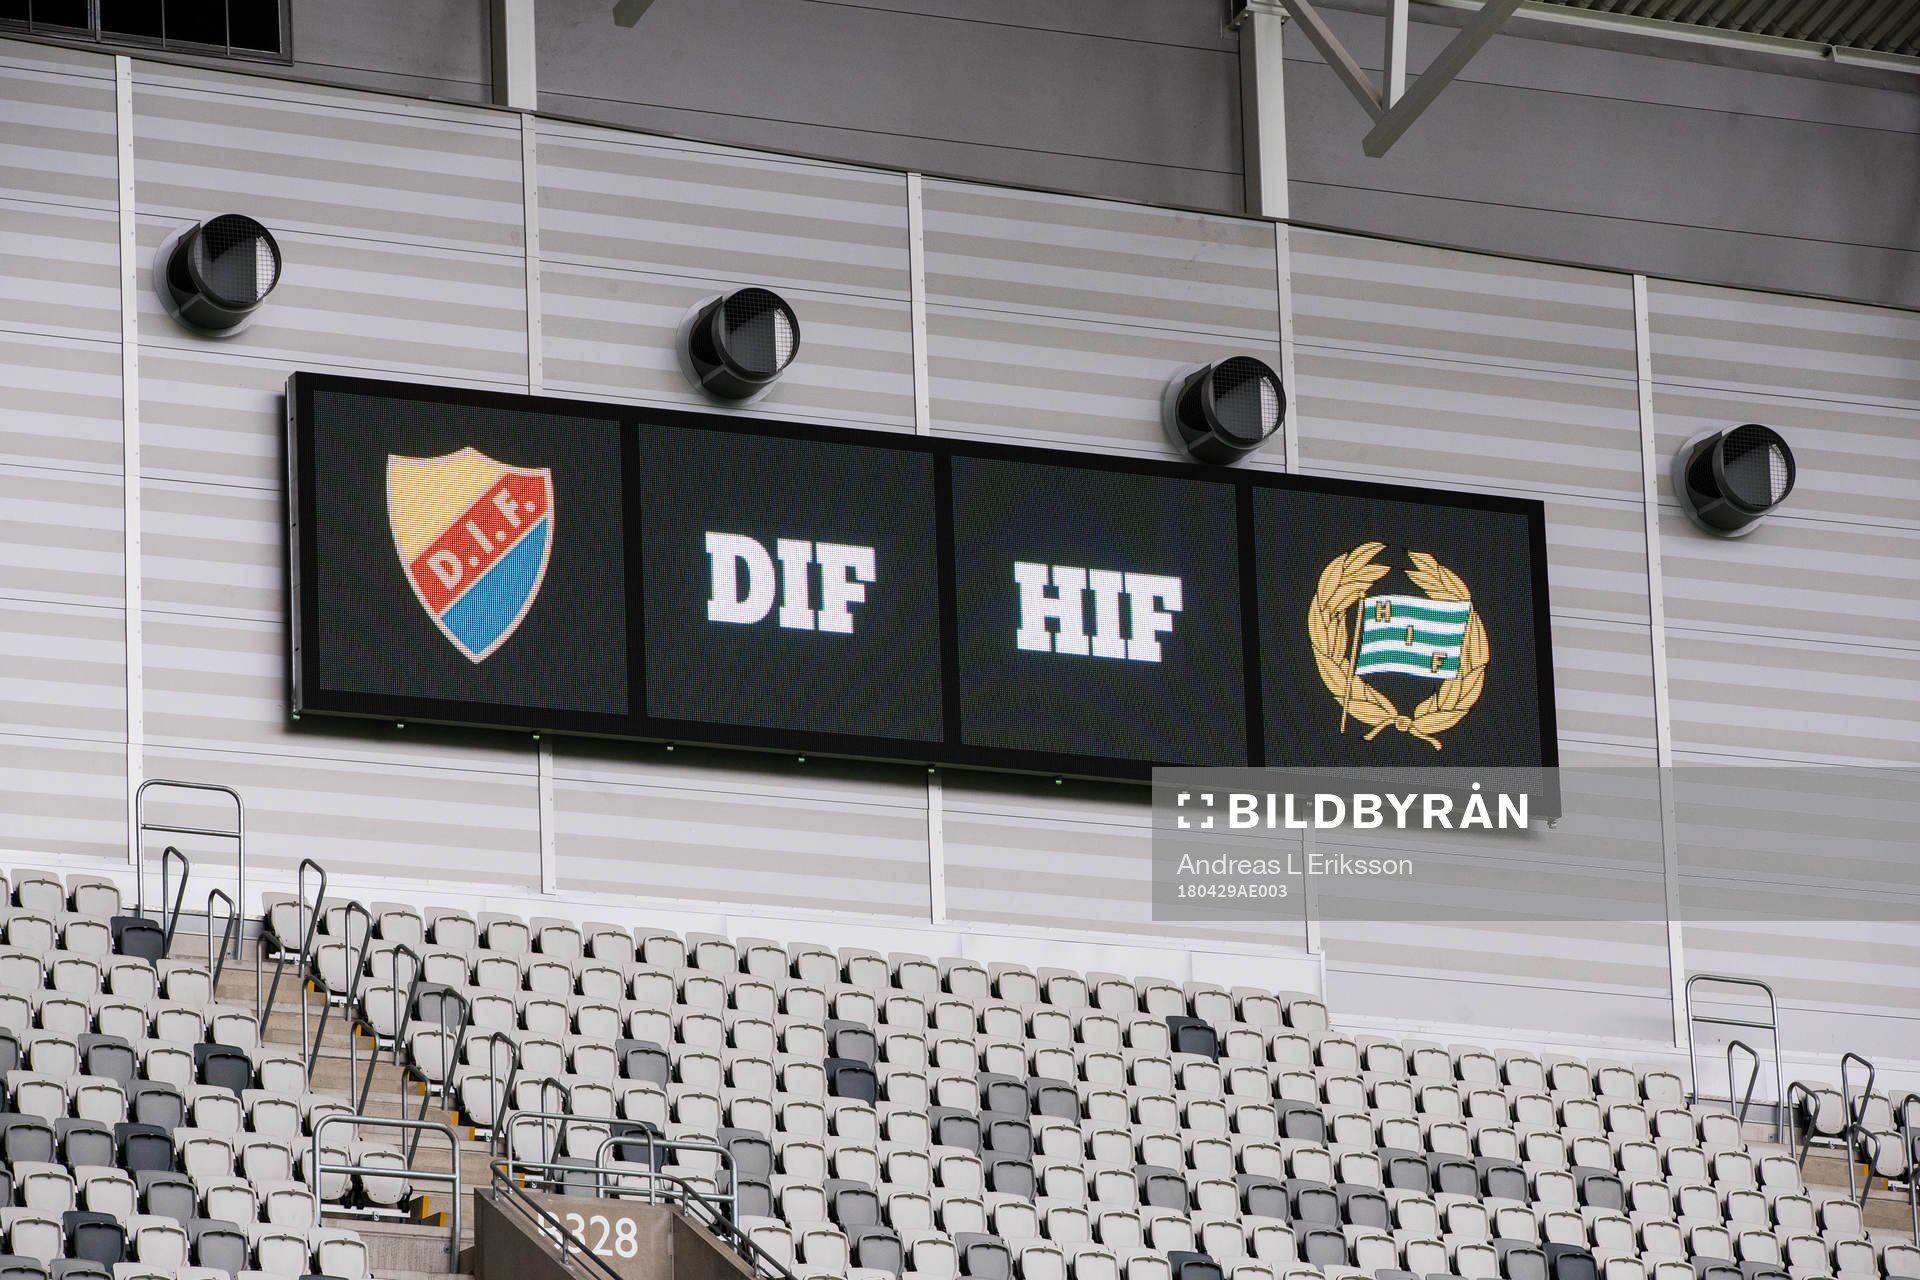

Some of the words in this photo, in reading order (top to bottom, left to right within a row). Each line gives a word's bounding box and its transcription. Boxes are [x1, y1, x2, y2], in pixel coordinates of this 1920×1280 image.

[426, 488, 537, 590] D.I.F.
[705, 530, 877, 634] DIF
[1014, 560, 1184, 663] HIF
